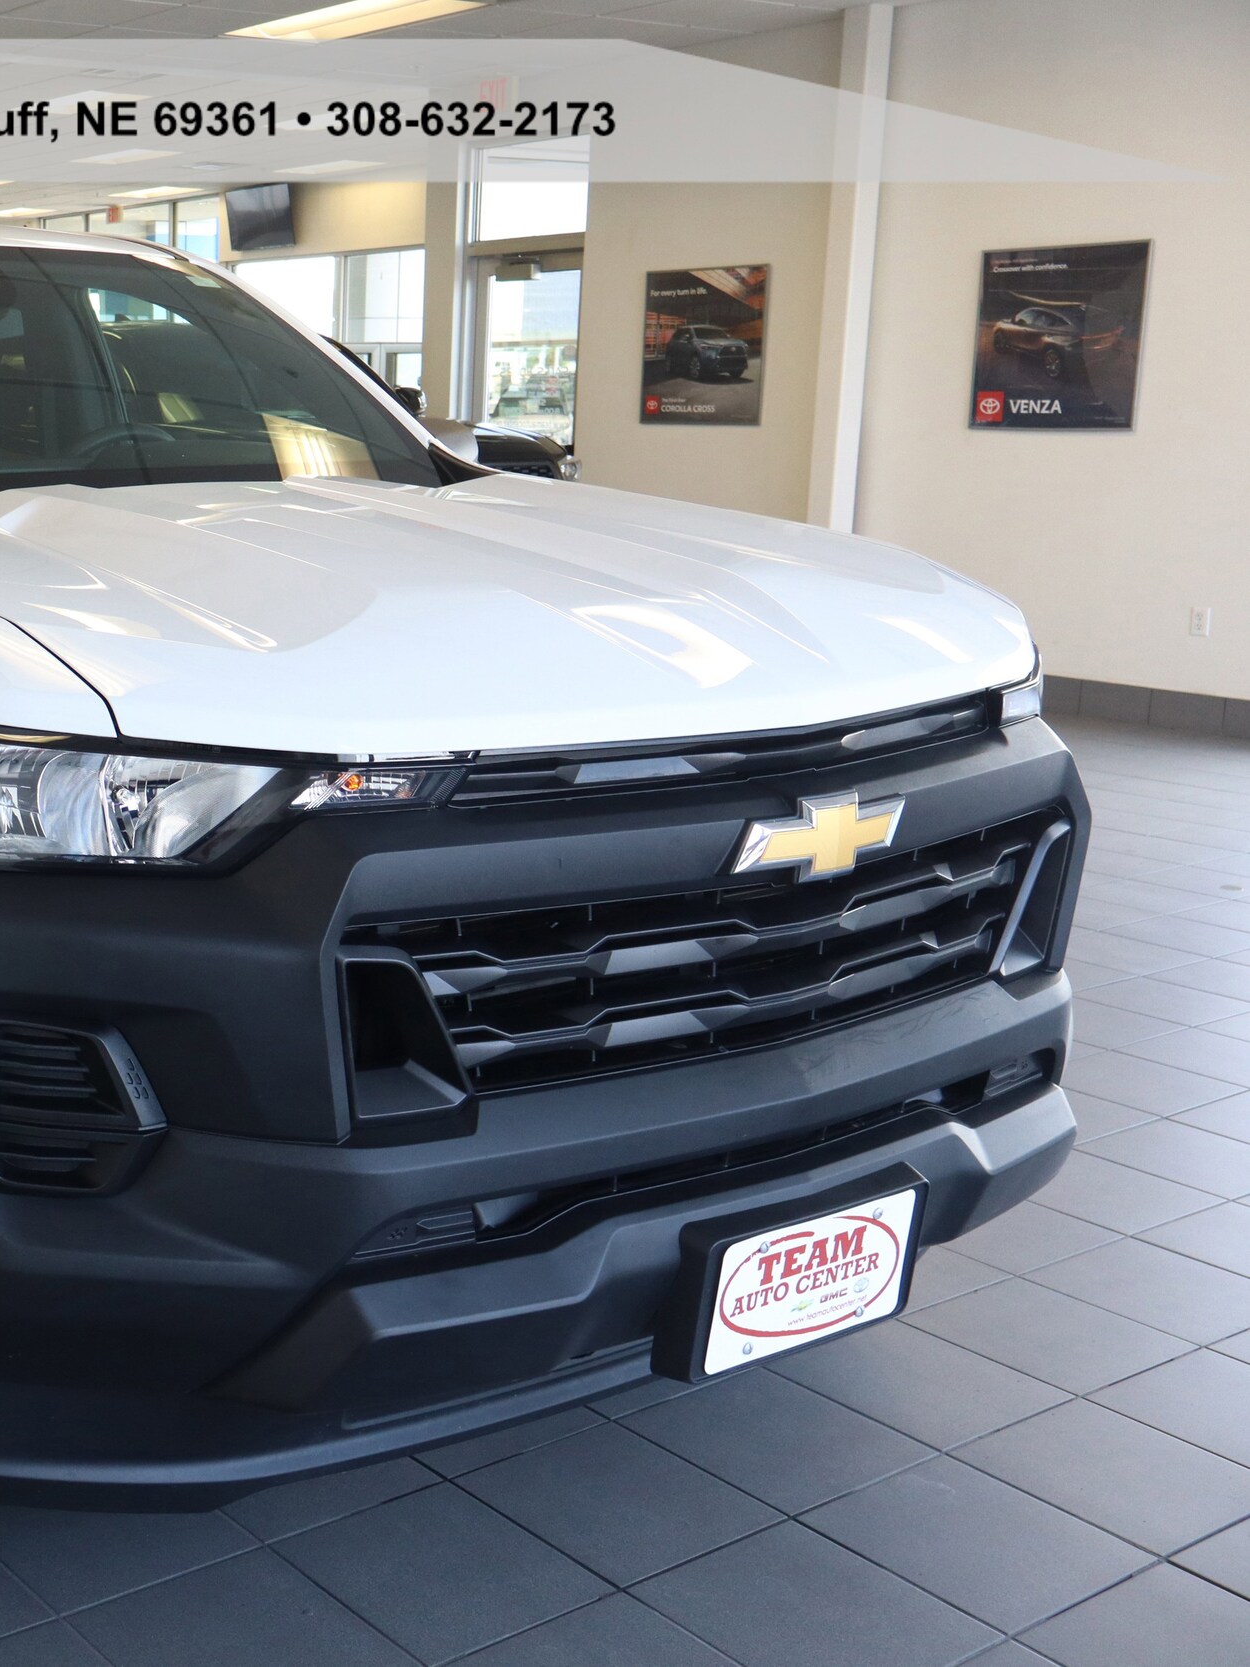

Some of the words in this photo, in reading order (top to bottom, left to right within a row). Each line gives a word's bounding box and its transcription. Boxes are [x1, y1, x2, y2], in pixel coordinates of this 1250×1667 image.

[650, 289, 660, 297] For
[660, 290, 676, 298] every
[676, 288, 689, 296] turn
[690, 287, 696, 295] in
[661, 404, 692, 413] COROLLA
[693, 404, 716, 413] CROSS
[1009, 399, 1062, 414] VENZA
[757, 1225, 868, 1287] TEAM
[729, 1281, 790, 1318] AUTO
[795, 1252, 880, 1295] CENTER
[819, 1287, 849, 1304] GMC
